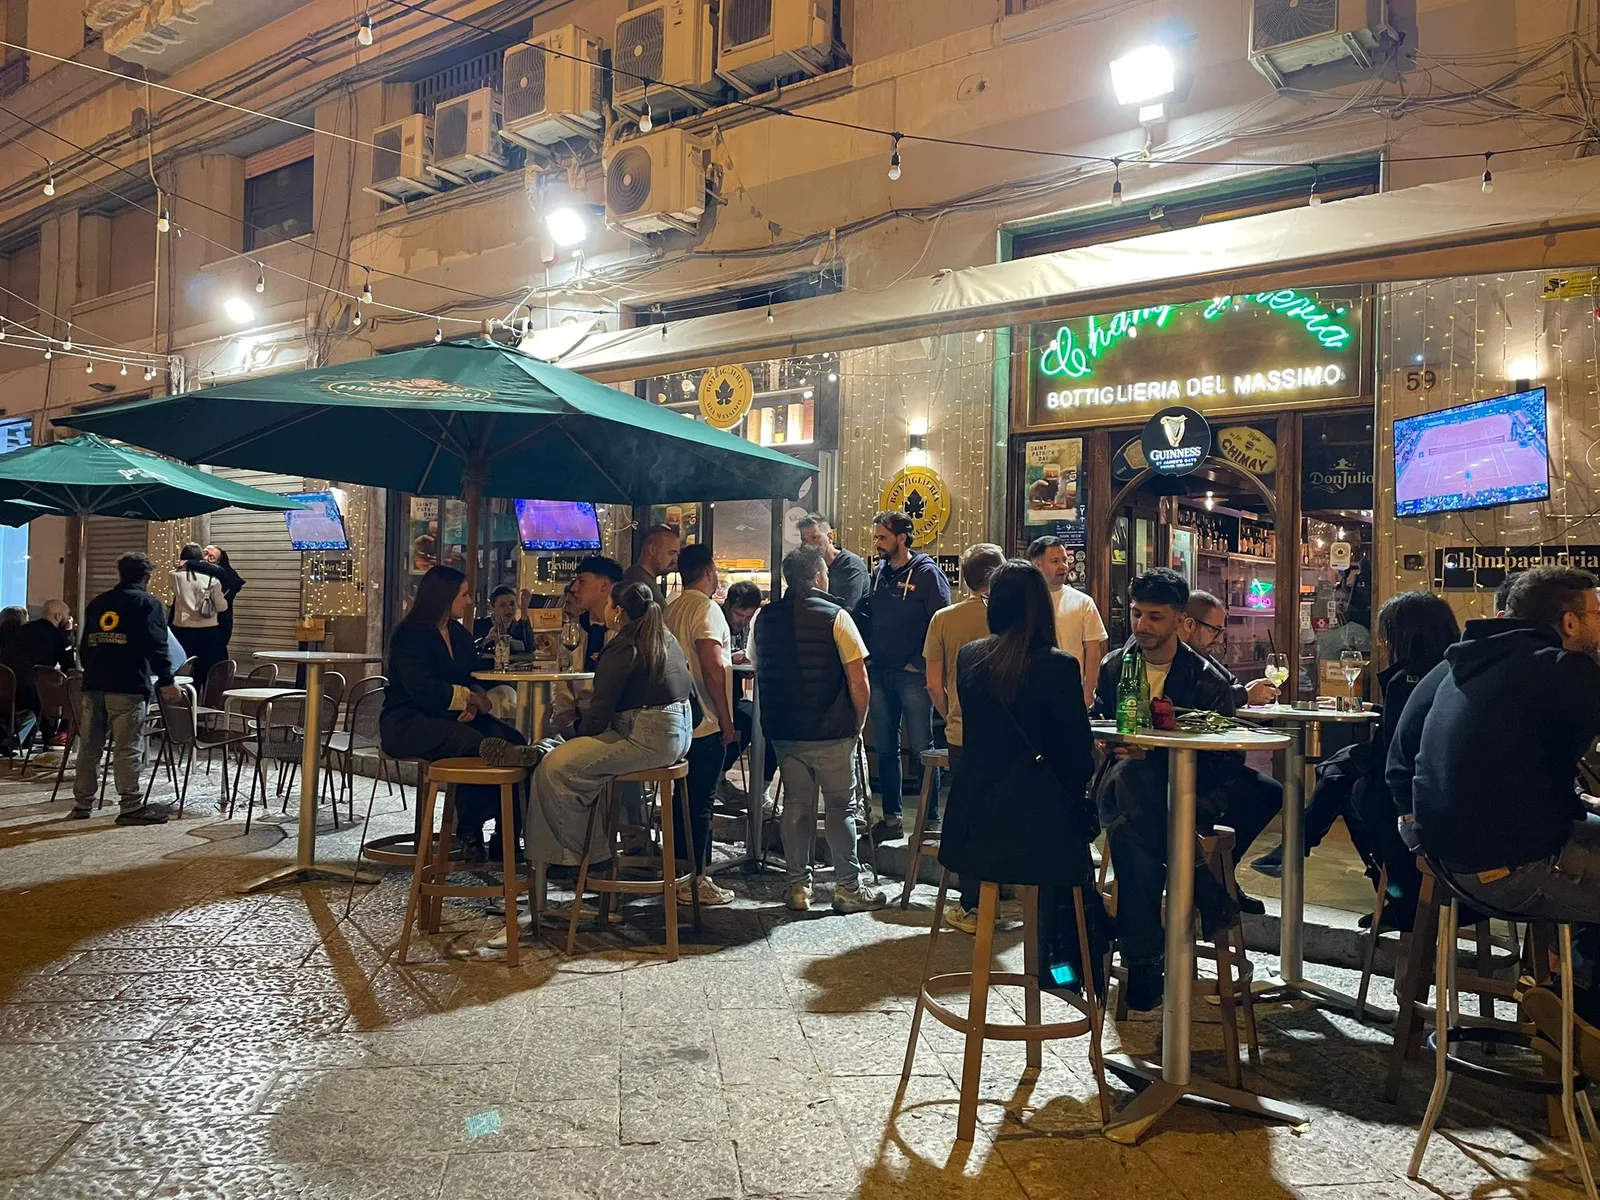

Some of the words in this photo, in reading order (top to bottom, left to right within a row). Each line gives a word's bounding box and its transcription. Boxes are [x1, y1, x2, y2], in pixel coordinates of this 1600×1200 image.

[1047, 380, 1181, 409] BOTTIGLIERIA
[1186, 375, 1227, 397] DEL
[1234, 364, 1342, 395] MASSIMO
[1407, 370, 1437, 391] 59
[1150, 446, 1202, 460] GUINNESS
[1222, 438, 1269, 471] CHIMAY
[1444, 550, 1600, 573] Champagneria
